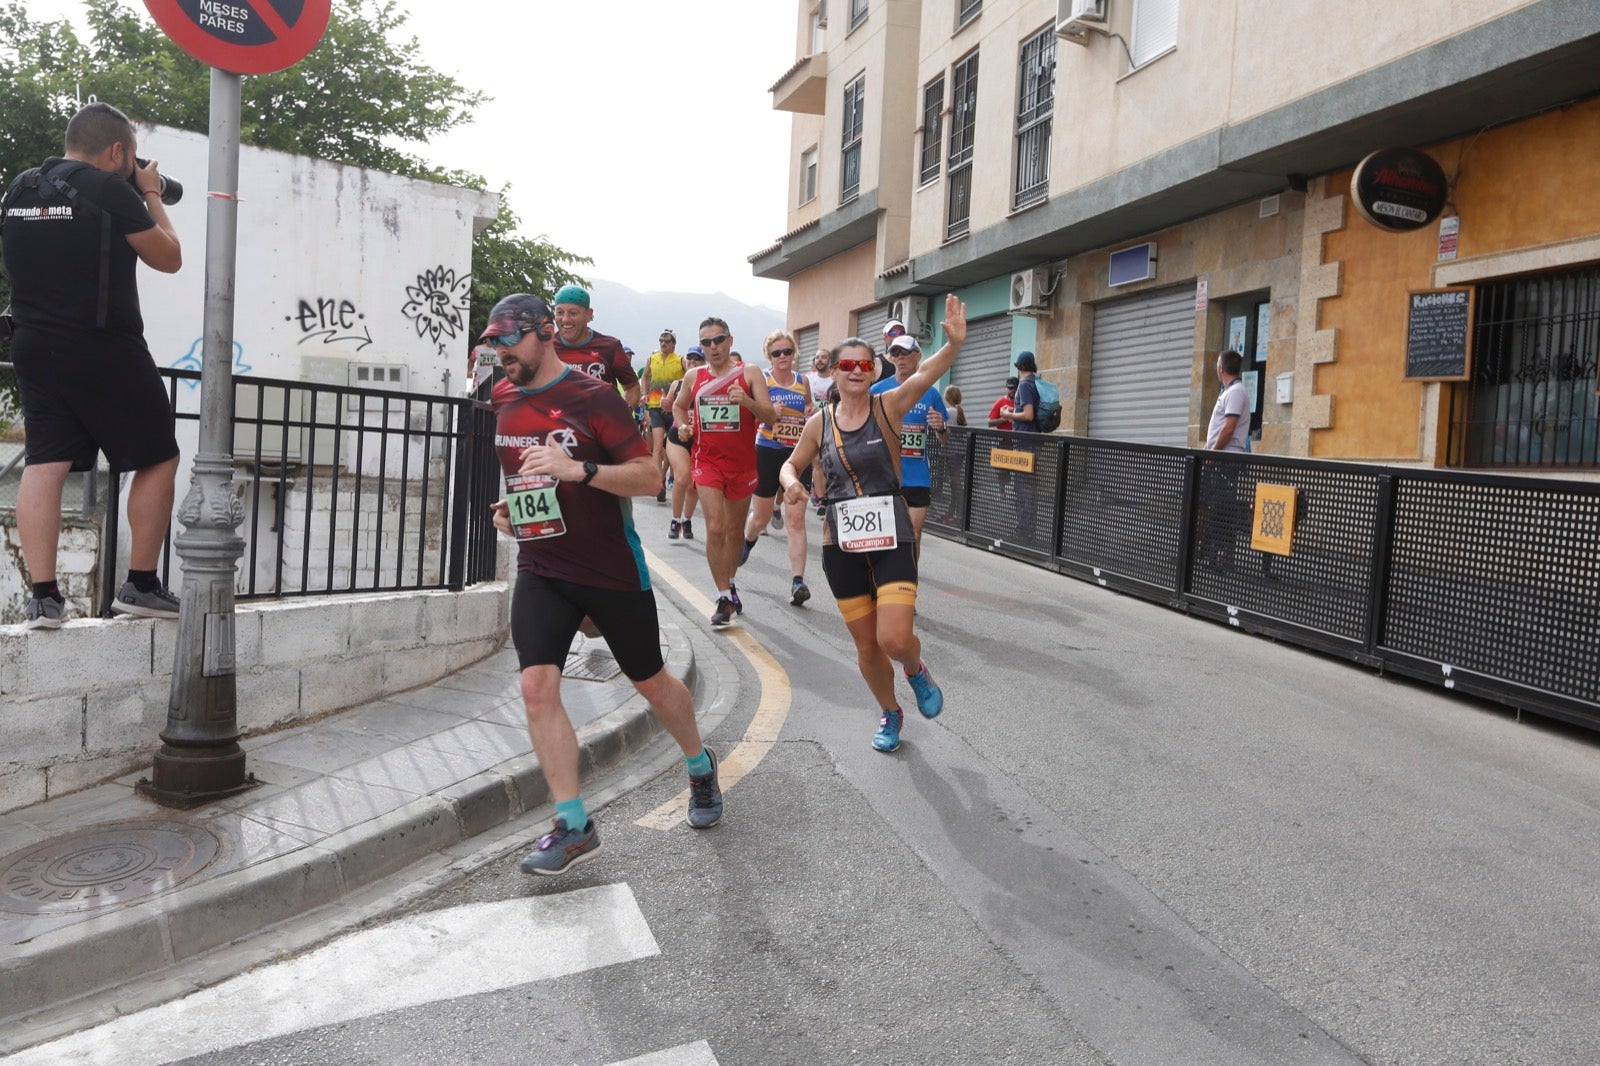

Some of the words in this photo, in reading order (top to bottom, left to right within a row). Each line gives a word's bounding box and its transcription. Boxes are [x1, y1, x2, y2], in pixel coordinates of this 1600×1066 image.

[200, 0, 249, 20] MESES
[199, 13, 245, 34] PARES
[710, 406, 729, 420] 72
[494, 434, 540, 448] RUNNERS
[514, 492, 550, 519] 184
[842, 511, 883, 534] 3081
[846, 538, 885, 549] Cruzcampo
